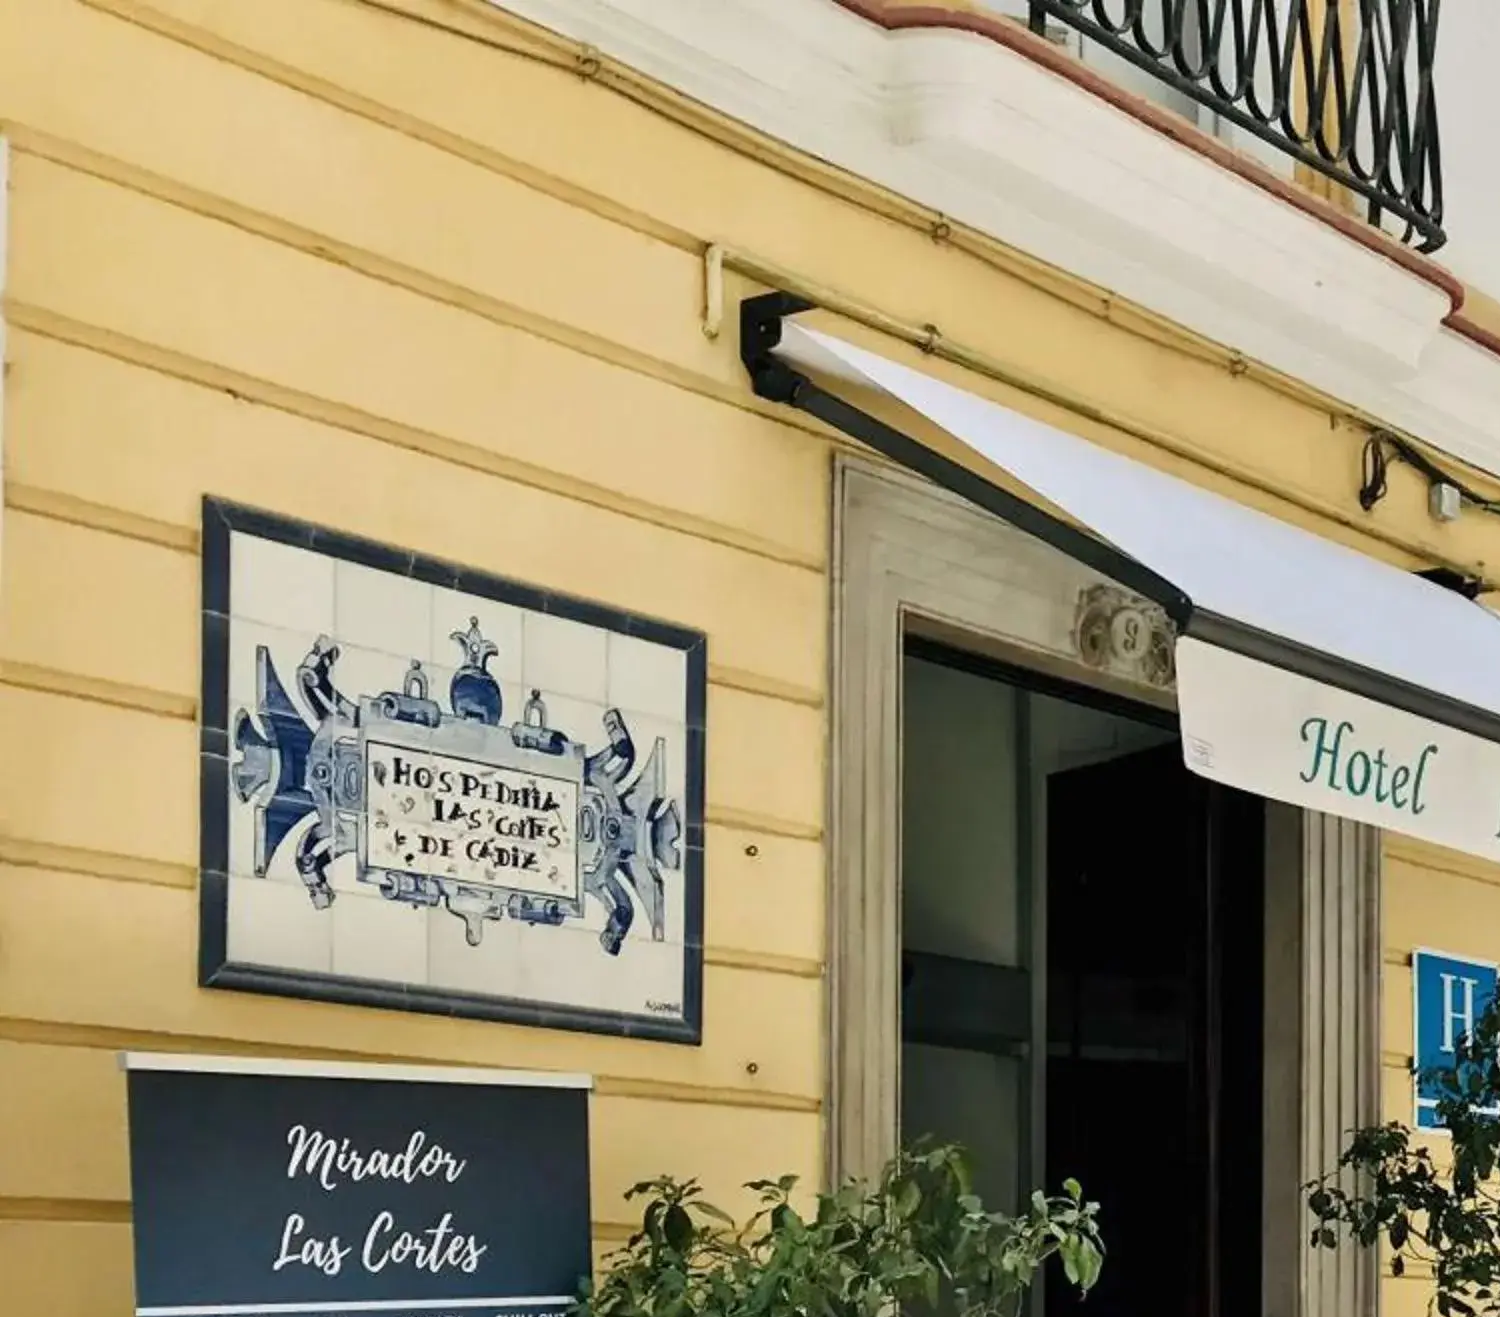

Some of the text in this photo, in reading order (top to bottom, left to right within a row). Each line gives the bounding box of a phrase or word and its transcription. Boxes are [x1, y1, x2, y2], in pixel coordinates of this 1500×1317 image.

[1299, 716, 1438, 815] Hotel
[417, 833, 456, 857] DE
[432, 798, 562, 849] LAS CORTES
[1439, 973, 1479, 1052] H
[287, 1124, 468, 1191] Mirador
[272, 1211, 488, 1275] Las Cortes
